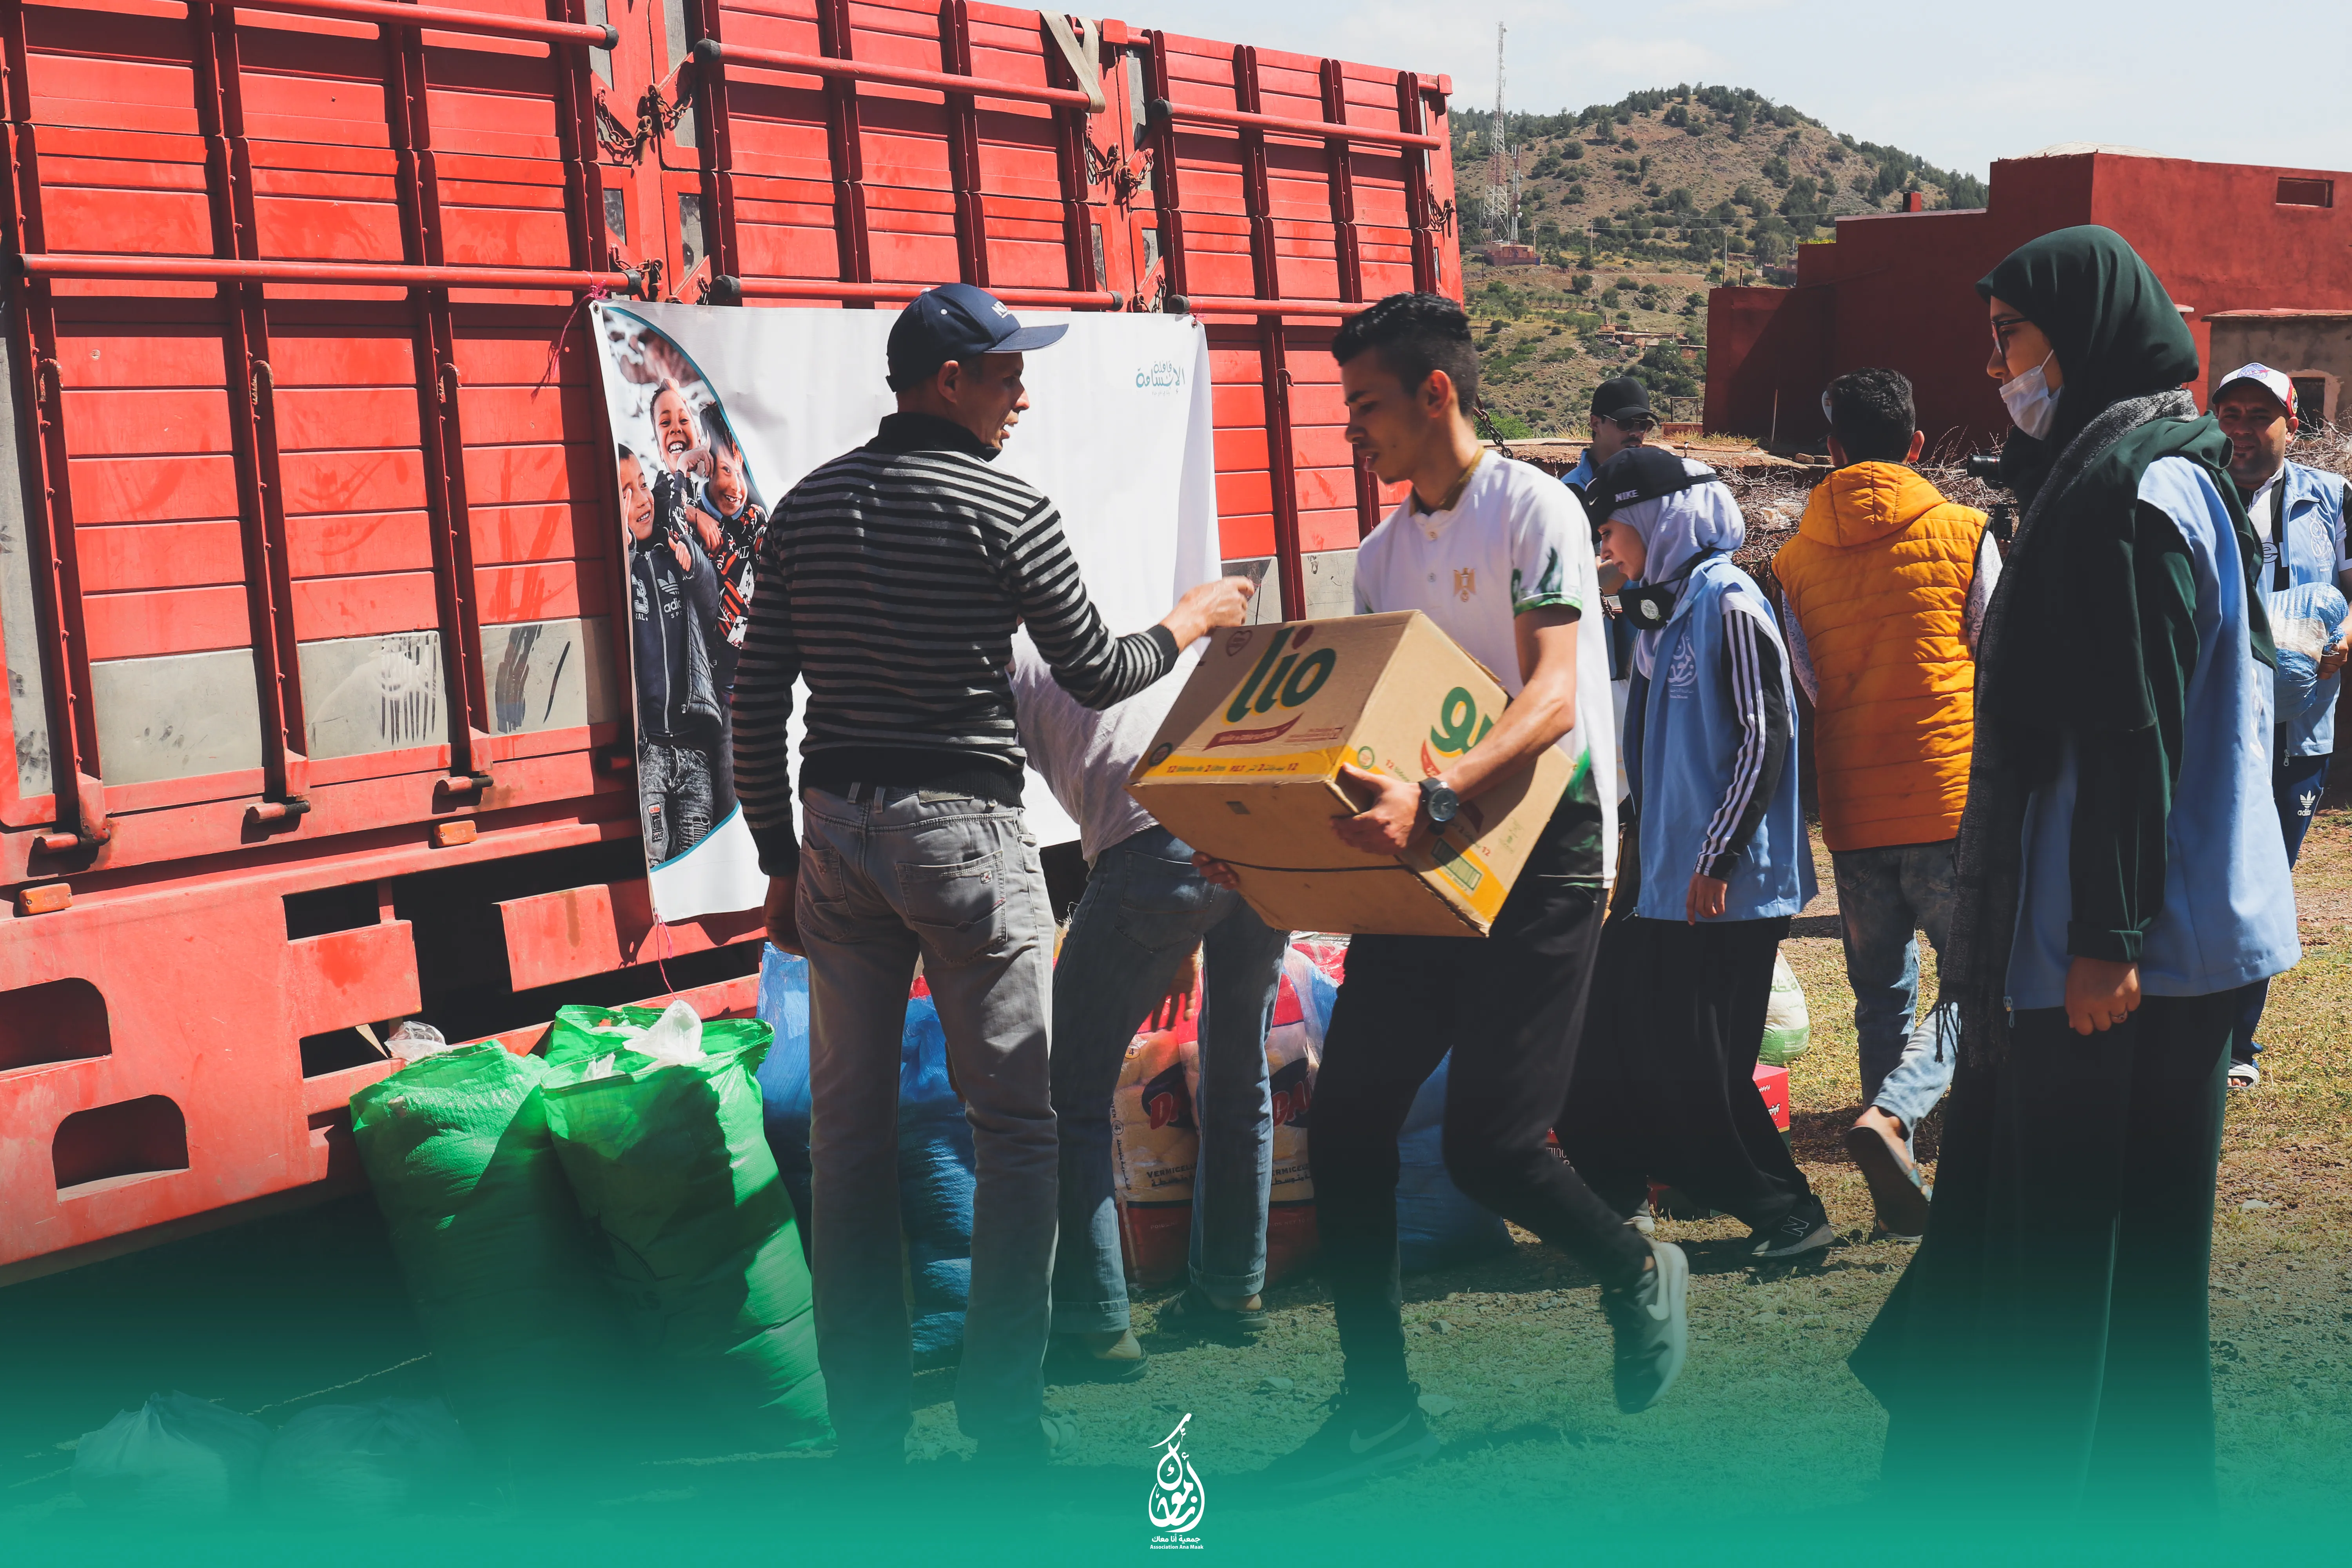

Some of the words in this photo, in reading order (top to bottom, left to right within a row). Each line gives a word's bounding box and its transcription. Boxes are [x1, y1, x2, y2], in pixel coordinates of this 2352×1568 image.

[1615, 490, 1639, 502] NIKE
[1272, 1163, 1310, 1176] ERMICELLE
[1271, 1174, 1304, 1185] متوسط
